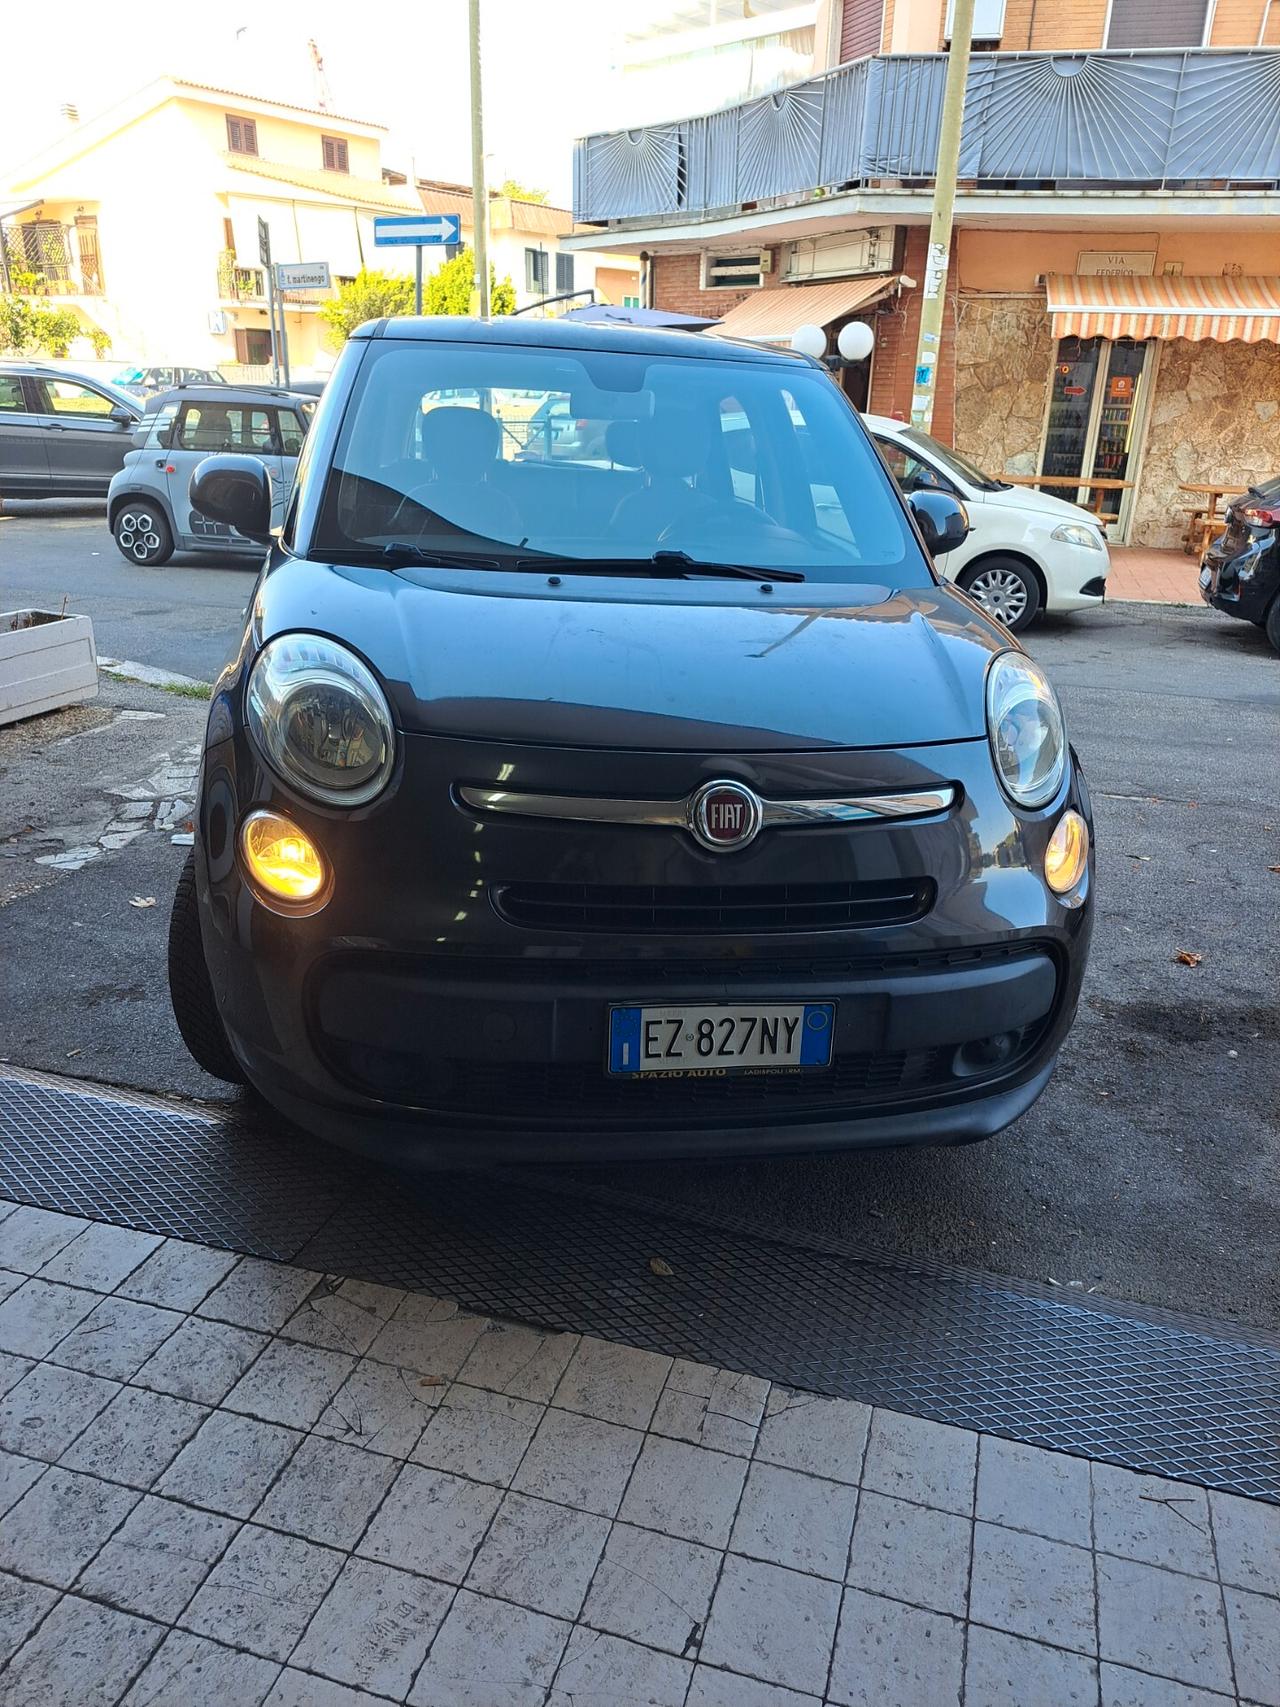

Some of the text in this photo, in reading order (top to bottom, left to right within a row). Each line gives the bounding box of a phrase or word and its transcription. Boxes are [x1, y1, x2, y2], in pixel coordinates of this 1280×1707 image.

[1108, 256, 1125, 265] VIA
[711, 803, 743, 829] FIAT
[644, 1016, 800, 1059] EZ 827NY
[631, 1068, 727, 1080] SPAZIO AUTO
